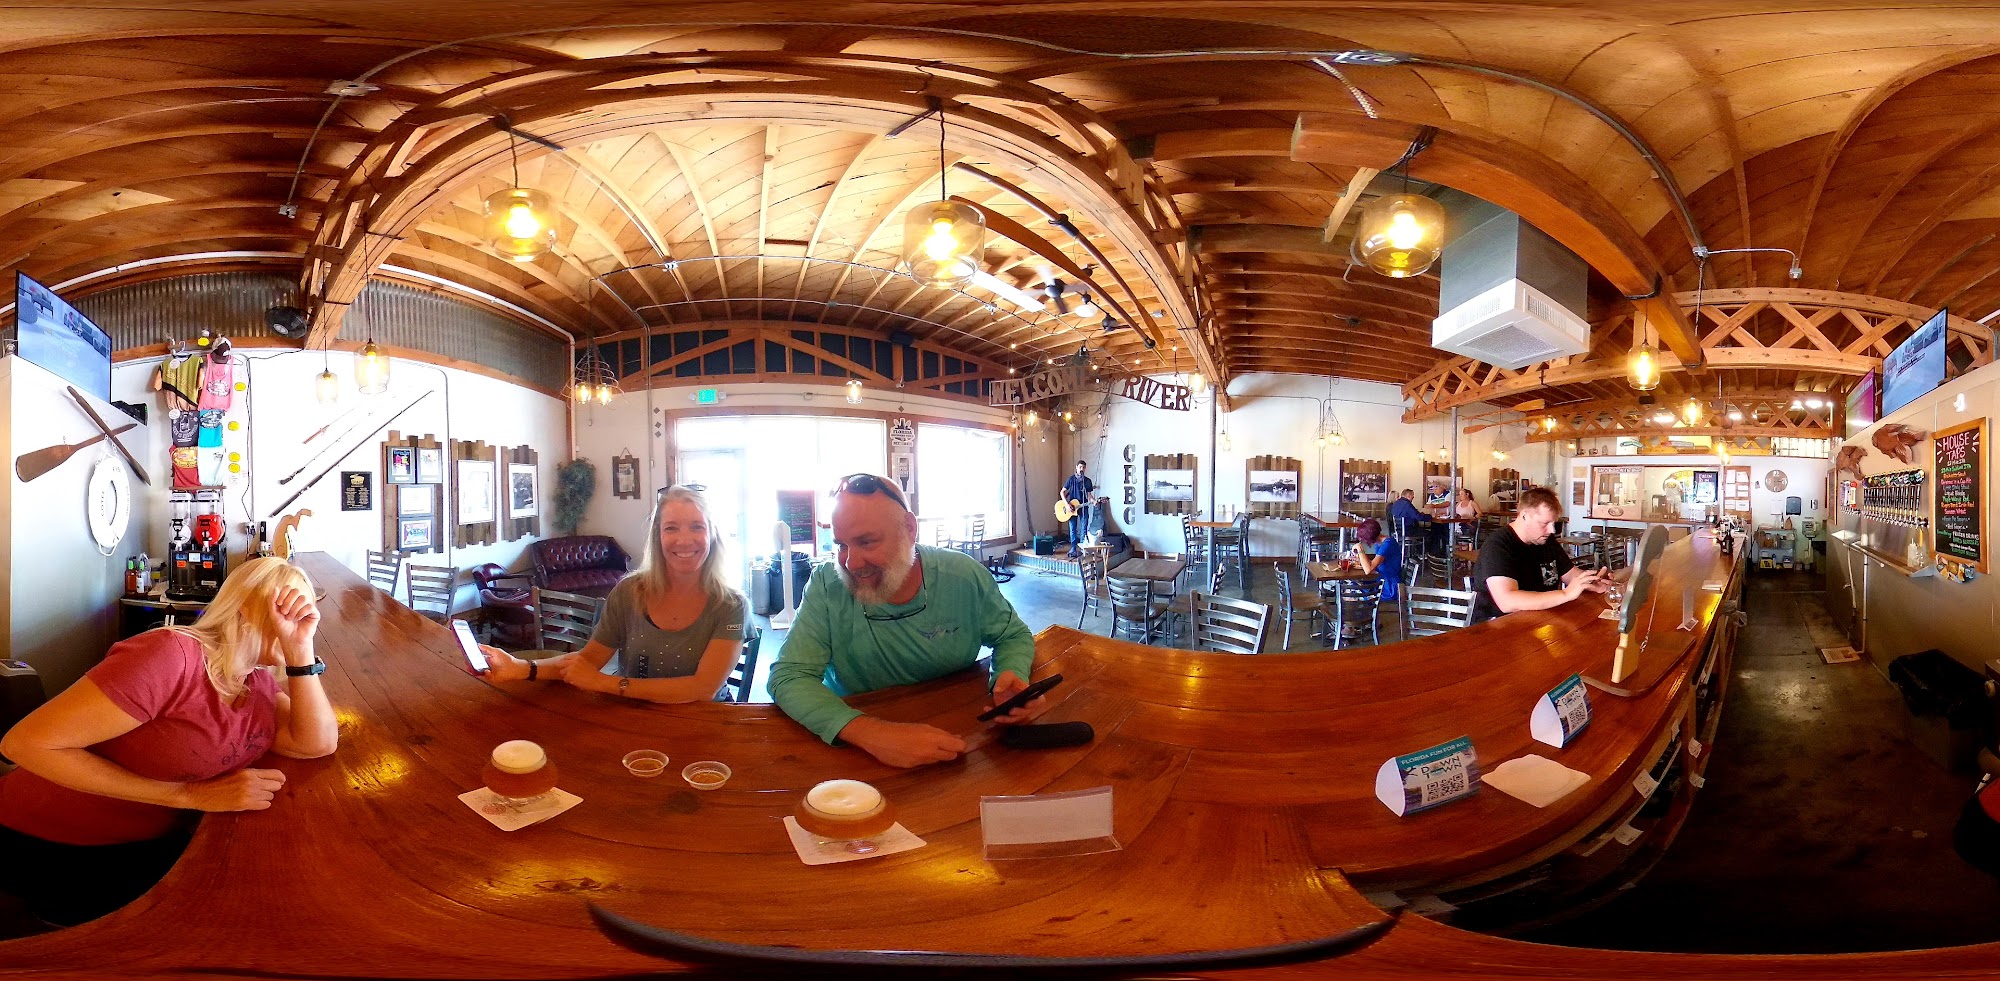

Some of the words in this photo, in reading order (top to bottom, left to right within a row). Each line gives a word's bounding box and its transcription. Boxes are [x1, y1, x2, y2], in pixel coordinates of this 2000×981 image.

[990, 368, 1092, 403] WELCOME
[1122, 373, 1191, 411] RIVER
[1942, 432, 1970, 451] HOUSE
[1946, 447, 1965, 460] TAPS
[1401, 755, 1429, 764] FLORIDA
[1442, 744, 1456, 752] FOR
